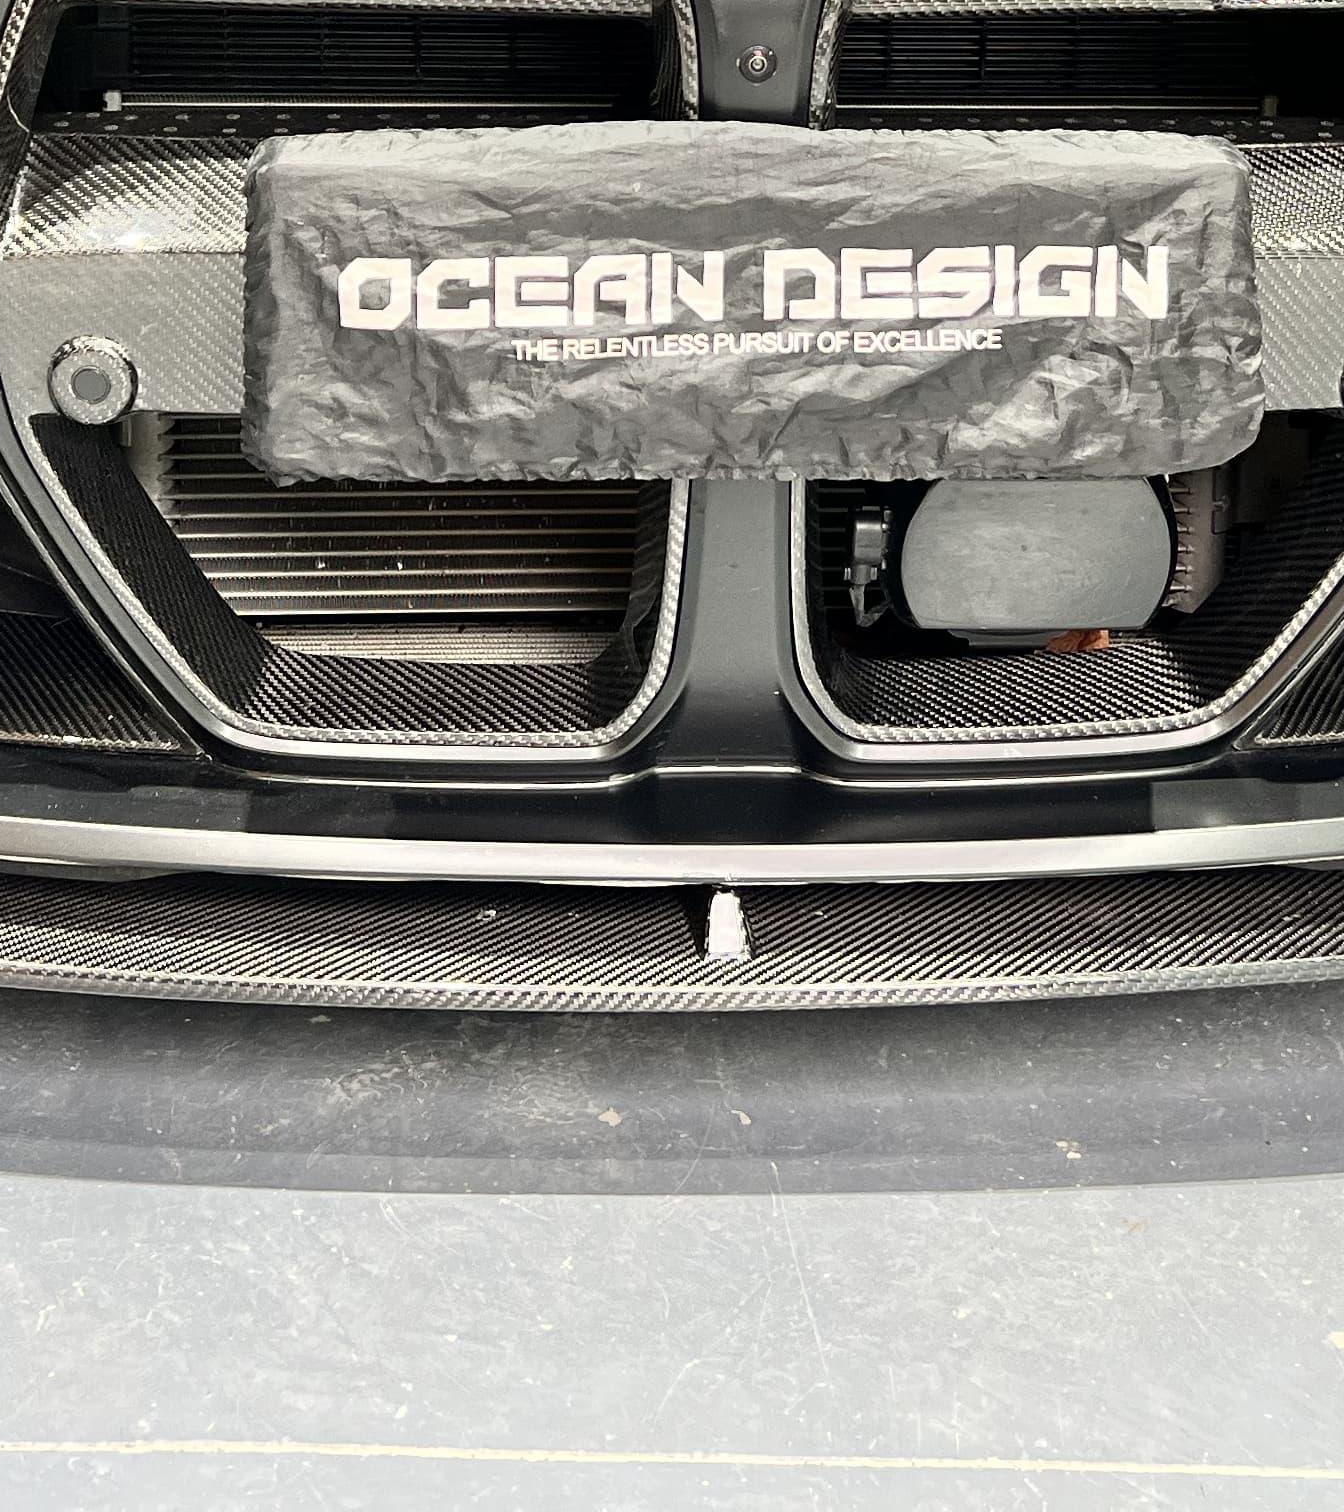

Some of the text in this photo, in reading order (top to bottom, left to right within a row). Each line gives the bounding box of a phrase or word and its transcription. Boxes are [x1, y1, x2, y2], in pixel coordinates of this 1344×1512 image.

[337, 244, 1169, 331] OCEAN DESIGN
[511, 328, 1003, 362] THE RELENTLESS PURSUIT OF EXCELLENCE
